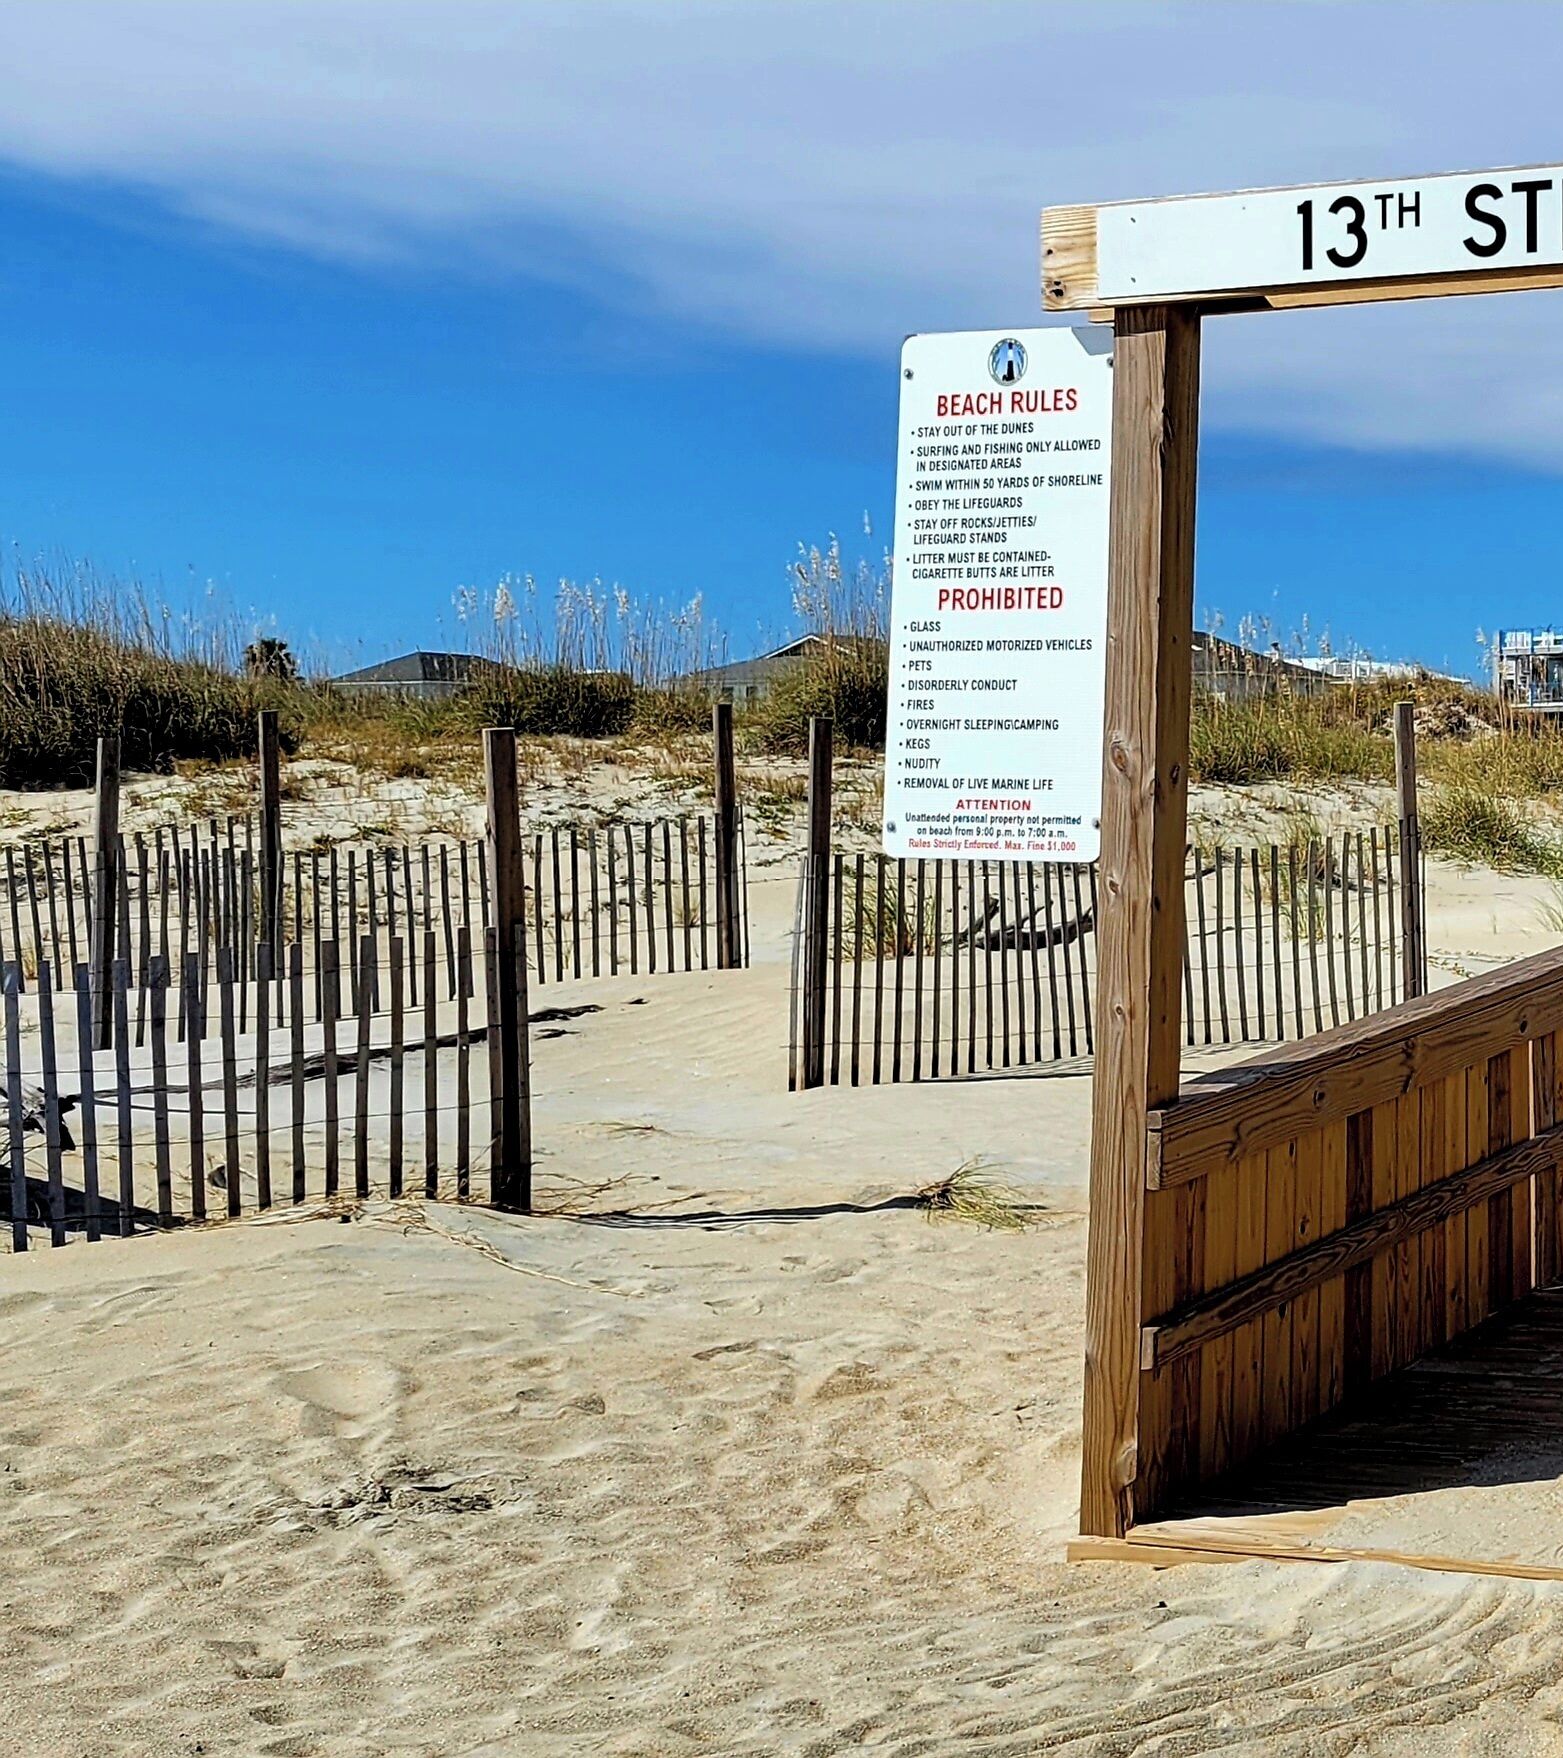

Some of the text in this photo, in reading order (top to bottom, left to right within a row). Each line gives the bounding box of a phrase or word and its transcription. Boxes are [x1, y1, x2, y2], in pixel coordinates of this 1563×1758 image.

[937, 388, 1077, 416] BEACH RULES
[918, 422, 1033, 437] STAY OUT OF THE DUNES
[917, 439, 1100, 457] SURFING AND FISHING ONLY ALLOWED
[917, 457, 1021, 472] IN DESIGNATED AREAS
[916, 474, 1102, 491] SWIM WITHIN 50 YARDS OF SHORELINE
[915, 497, 1022, 510] OBEY THE LIFEGUARDS
[914, 516, 1037, 530] STAY OFF ROCKS/JETTIES/
[914, 532, 1007, 545] LIFEGUARD STANDS
[913, 551, 1051, 564] LITTER MUST BE CONTAINED-
[913, 566, 1054, 579] CIGARETTE BUTTS ARE LITTER
[939, 587, 1062, 610] PROHIBITED
[910, 621, 941, 632] GLASS
[910, 639, 1092, 651] UNAUTHORIZED MOTORIZED VEHICLES
[909, 660, 932, 671] PETS
[908, 679, 1017, 690] DISORDERLY CONDUCT
[907, 699, 934, 710] FIRES
[907, 719, 961, 730] OVERNIGHT
[906, 738, 930, 749] KEGS
[905, 758, 941, 769] NUDITY
[904, 778, 1053, 790] REMOVAL OF LIVE MARINE LIFE
[956, 799, 1030, 810] ATTENTION
[905, 812, 1081, 826] Unattended personal property not permitted
[929, 826, 952, 835] beach
[955, 826, 973, 836] from
[976, 826, 994, 836] 9:00
[996, 829, 1015, 838] p.m.
[1018, 828, 1025, 837] to
[1028, 827, 1046, 837] 7:00
[1048, 830, 1067, 838] a.m.
[909, 838, 1076, 851] Rules Strictly Enforced. Max. Fine $1,000
